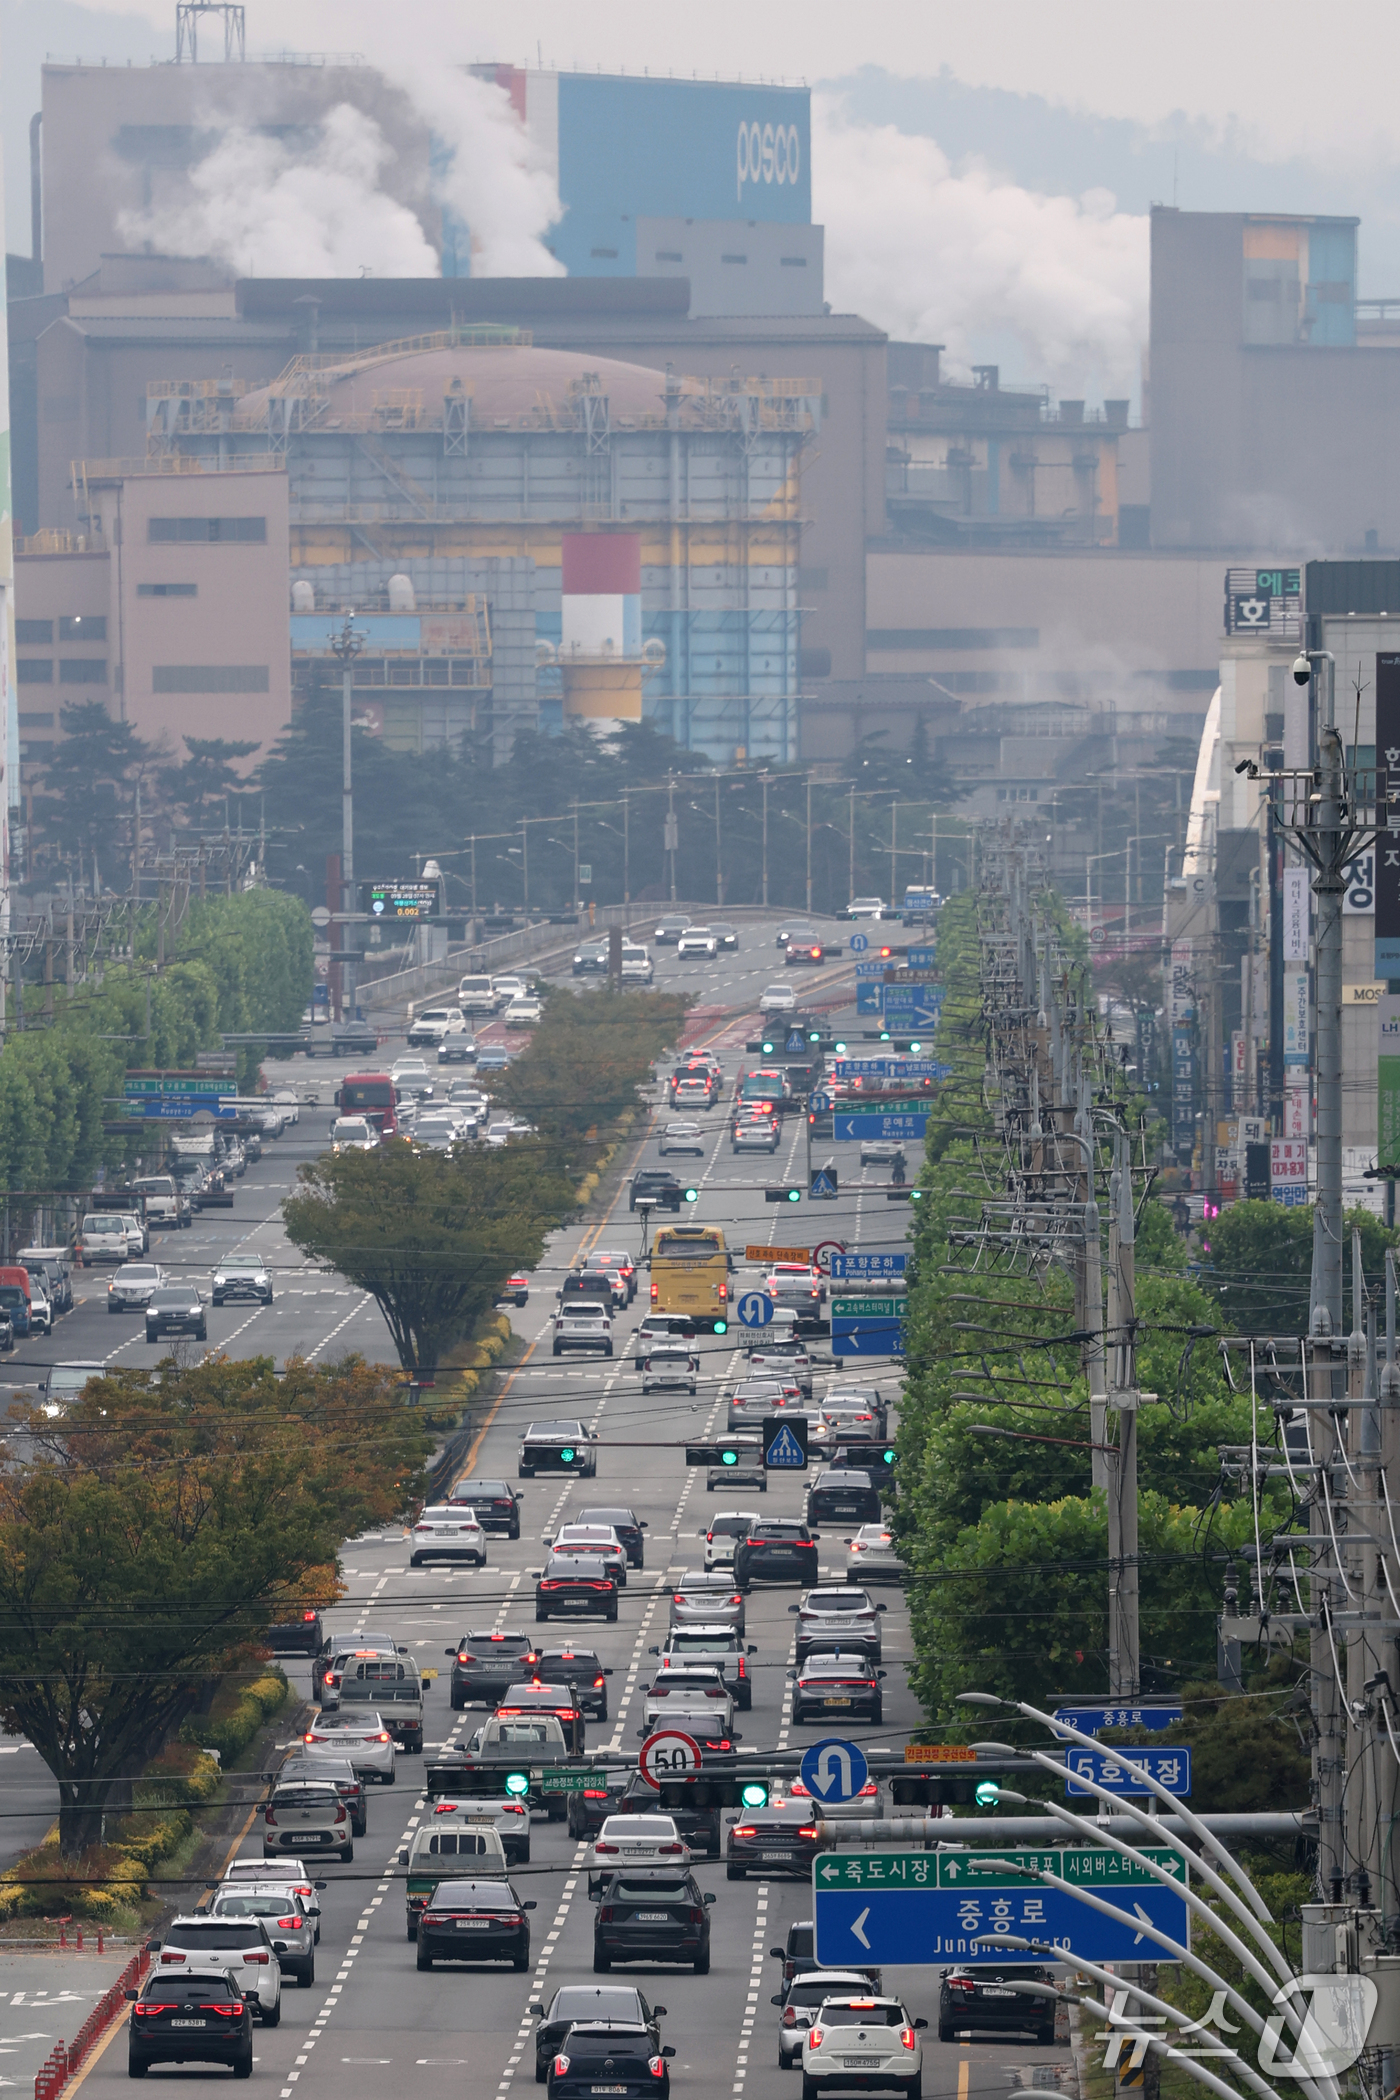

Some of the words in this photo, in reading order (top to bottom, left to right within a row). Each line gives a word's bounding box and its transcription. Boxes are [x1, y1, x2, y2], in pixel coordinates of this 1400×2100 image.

[397, 908, 419, 916] 0.002
[1298, 986, 1306, 1051] 주간보호센터
[1382, 1023, 1398, 1032] LH
[1141, 1022, 1152, 1082] HOTEL
[845, 1062, 878, 1071] 포항운하
[906, 1063, 936, 1072] 남포항IC
[883, 1117, 914, 1129] 문예로
[776, 1251, 804, 1261] 단속장비
[845, 1257, 894, 1268] 포항운하
[845, 1269, 867, 1278] Pohang
[845, 1302, 891, 1313] 고속버스터미널
[1102, 1711, 1143, 1727] 중흥로
[654, 1747, 687, 1770] 50
[907, 1748, 940, 1759] 긴급차량
[576, 1776, 605, 1788] 수집장치
[845, 1860, 930, 1883] 죽도시장
[956, 1899, 1047, 1934] 중흥로
